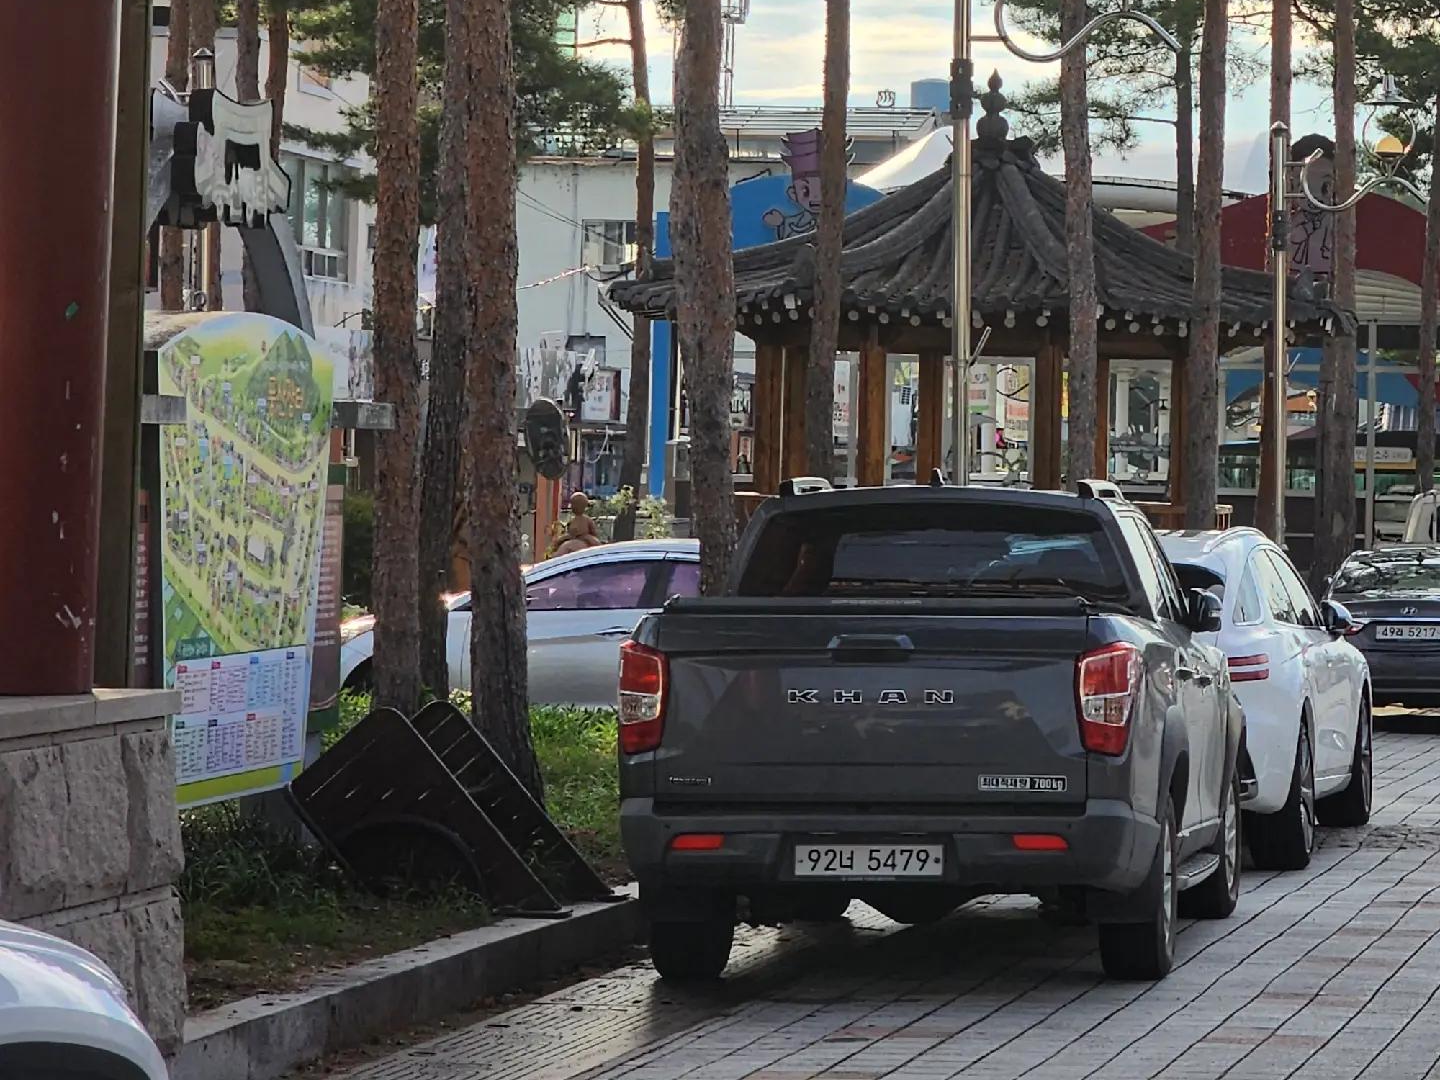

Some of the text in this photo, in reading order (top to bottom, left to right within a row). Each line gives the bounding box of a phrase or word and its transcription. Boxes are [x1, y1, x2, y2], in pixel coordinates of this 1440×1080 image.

[787, 689, 955, 704] KHAN
[808, 849, 930, 871] 92너 5479
